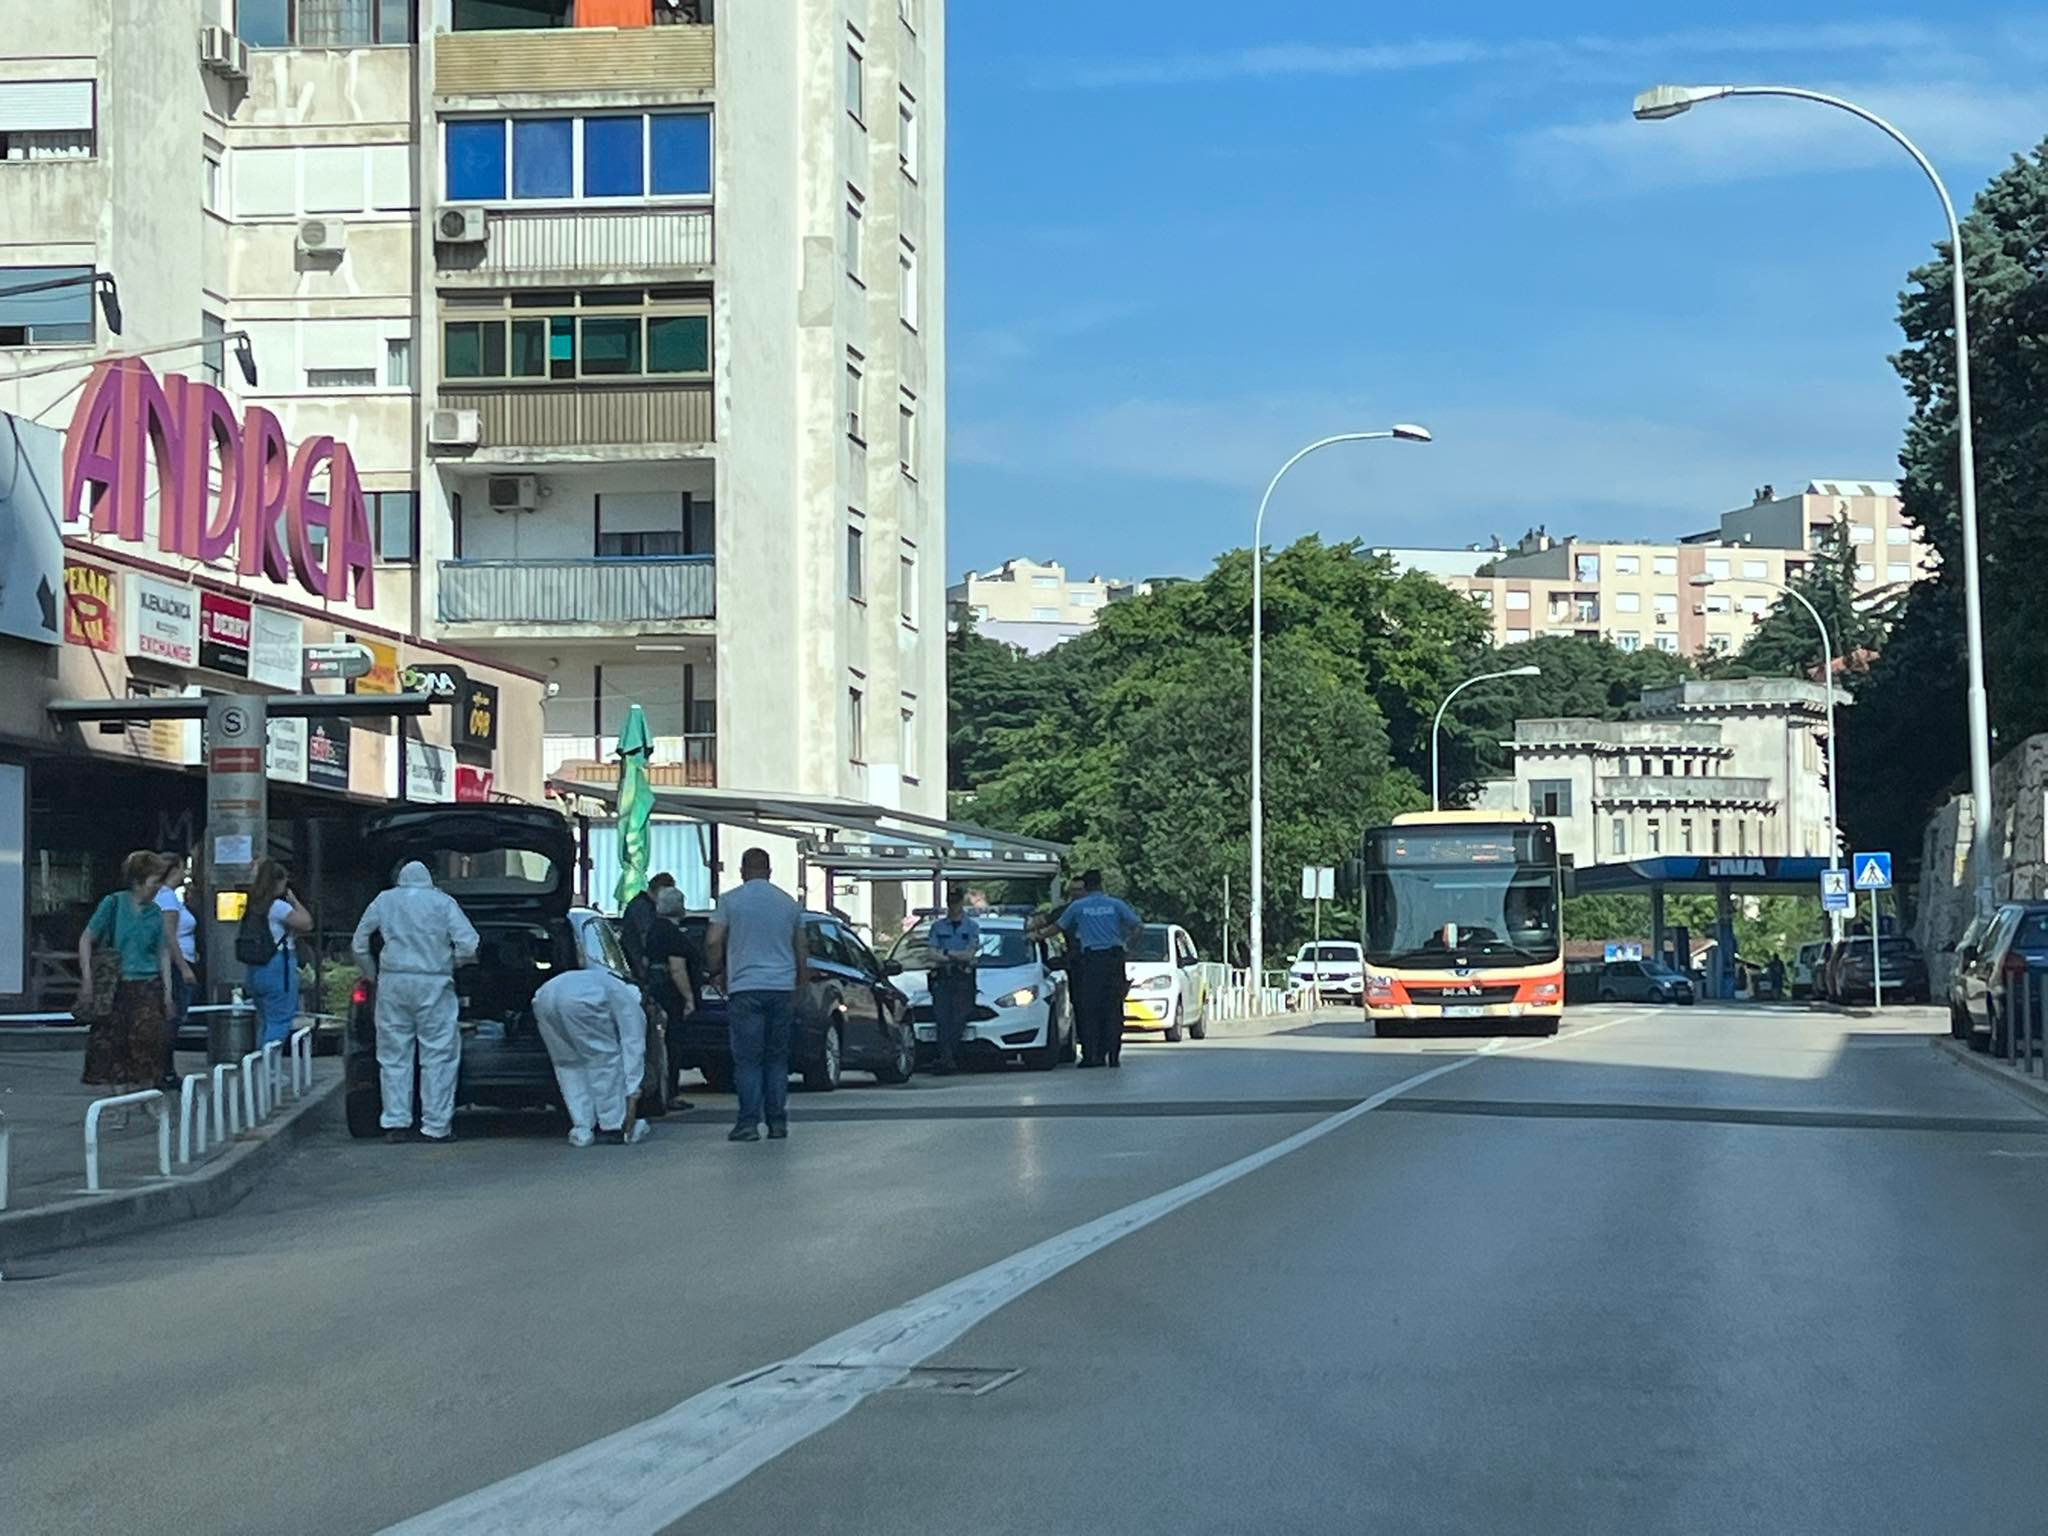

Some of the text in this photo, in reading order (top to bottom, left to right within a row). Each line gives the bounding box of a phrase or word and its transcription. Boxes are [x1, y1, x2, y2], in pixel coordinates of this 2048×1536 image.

[62, 351, 375, 610] ANDREA
[223, 711, 242, 733] S
[1442, 984, 1482, 997] MAN
